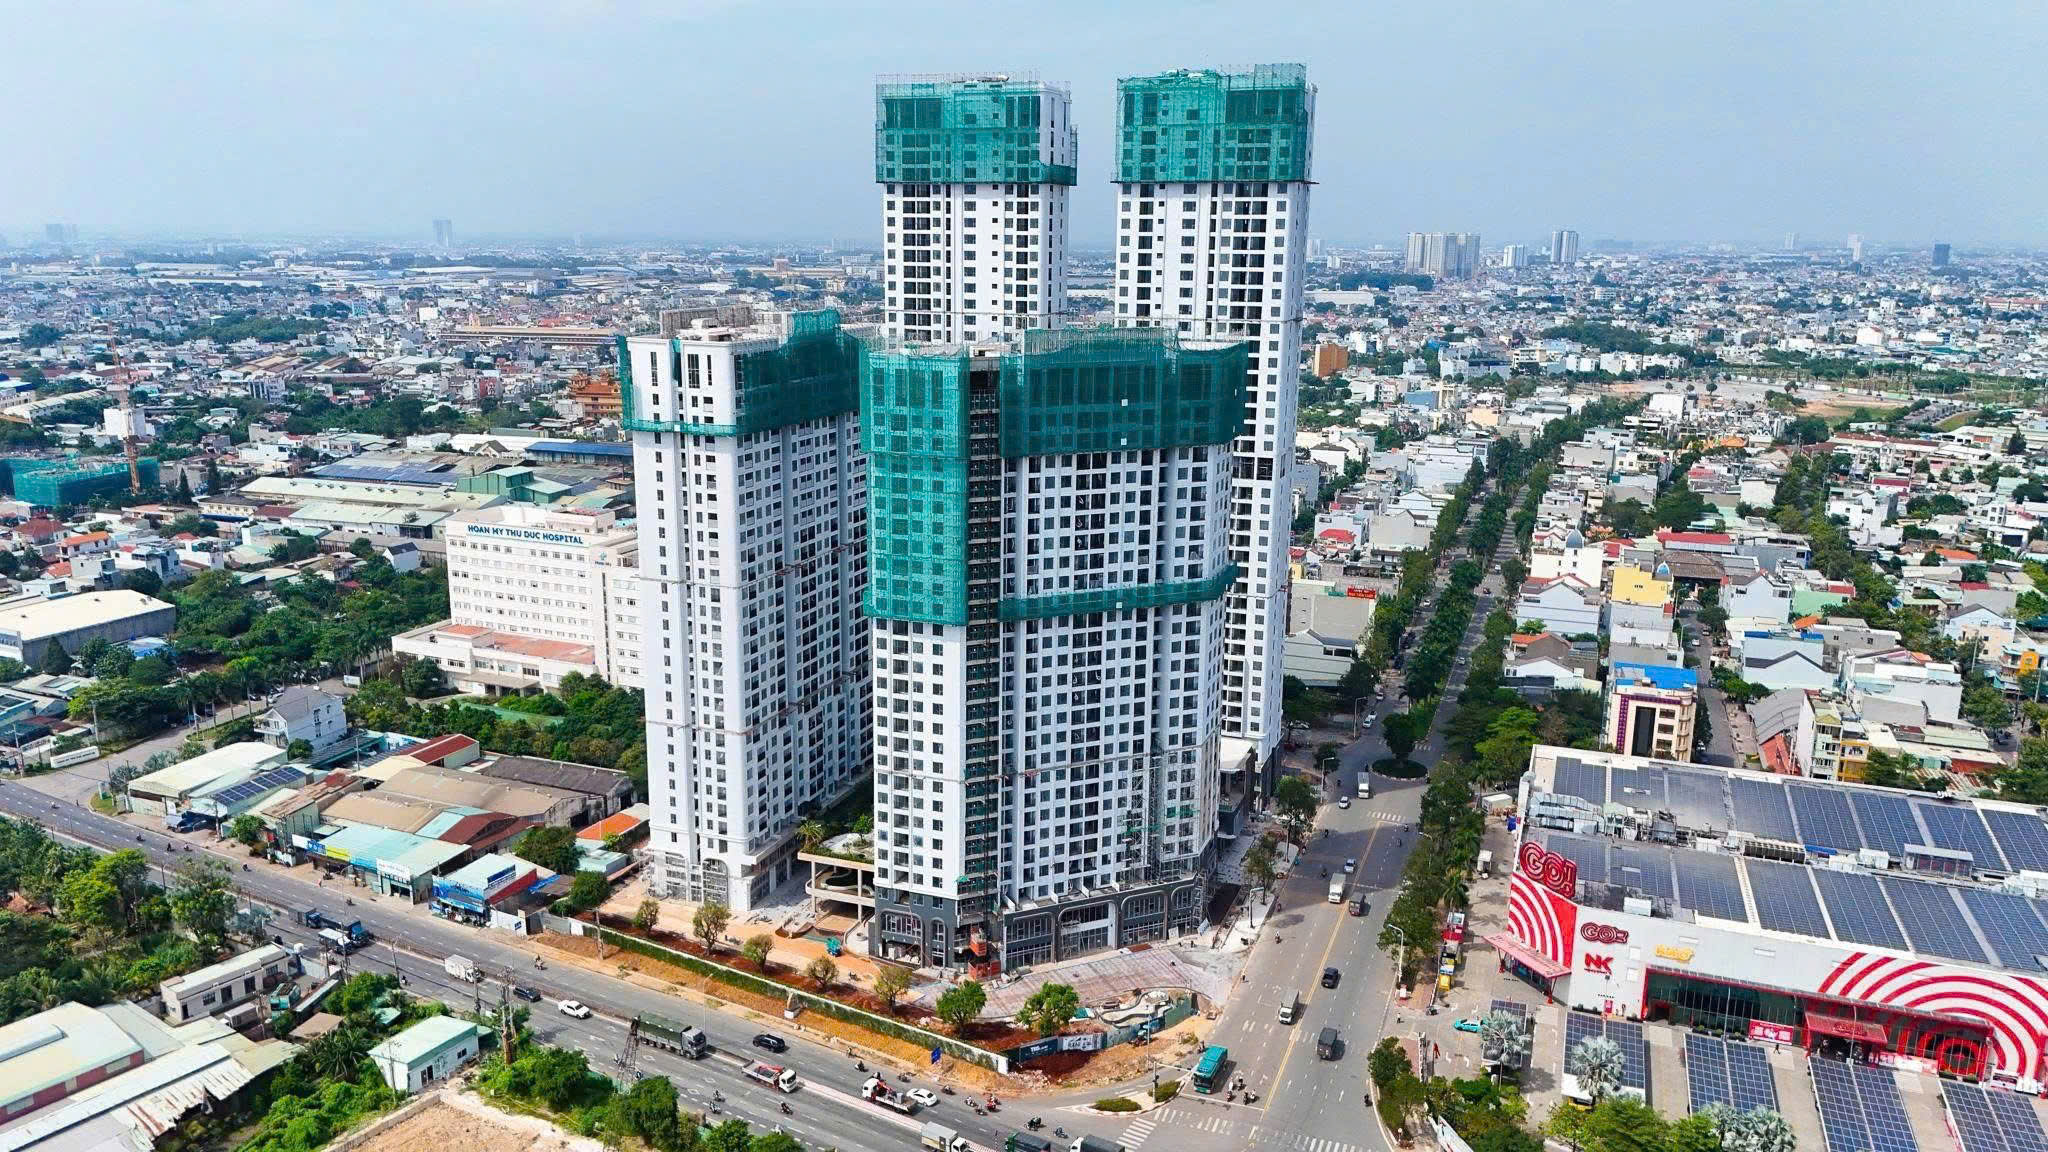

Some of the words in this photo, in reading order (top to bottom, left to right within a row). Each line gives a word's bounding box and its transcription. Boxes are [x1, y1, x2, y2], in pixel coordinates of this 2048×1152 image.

[468, 525, 490, 533] HOAN
[505, 529, 522, 537] THU
[524, 530, 540, 539] DUC
[543, 533, 583, 544] HOSPITAL
[1519, 841, 1576, 898] GO!
[1585, 953, 1614, 974] NK
